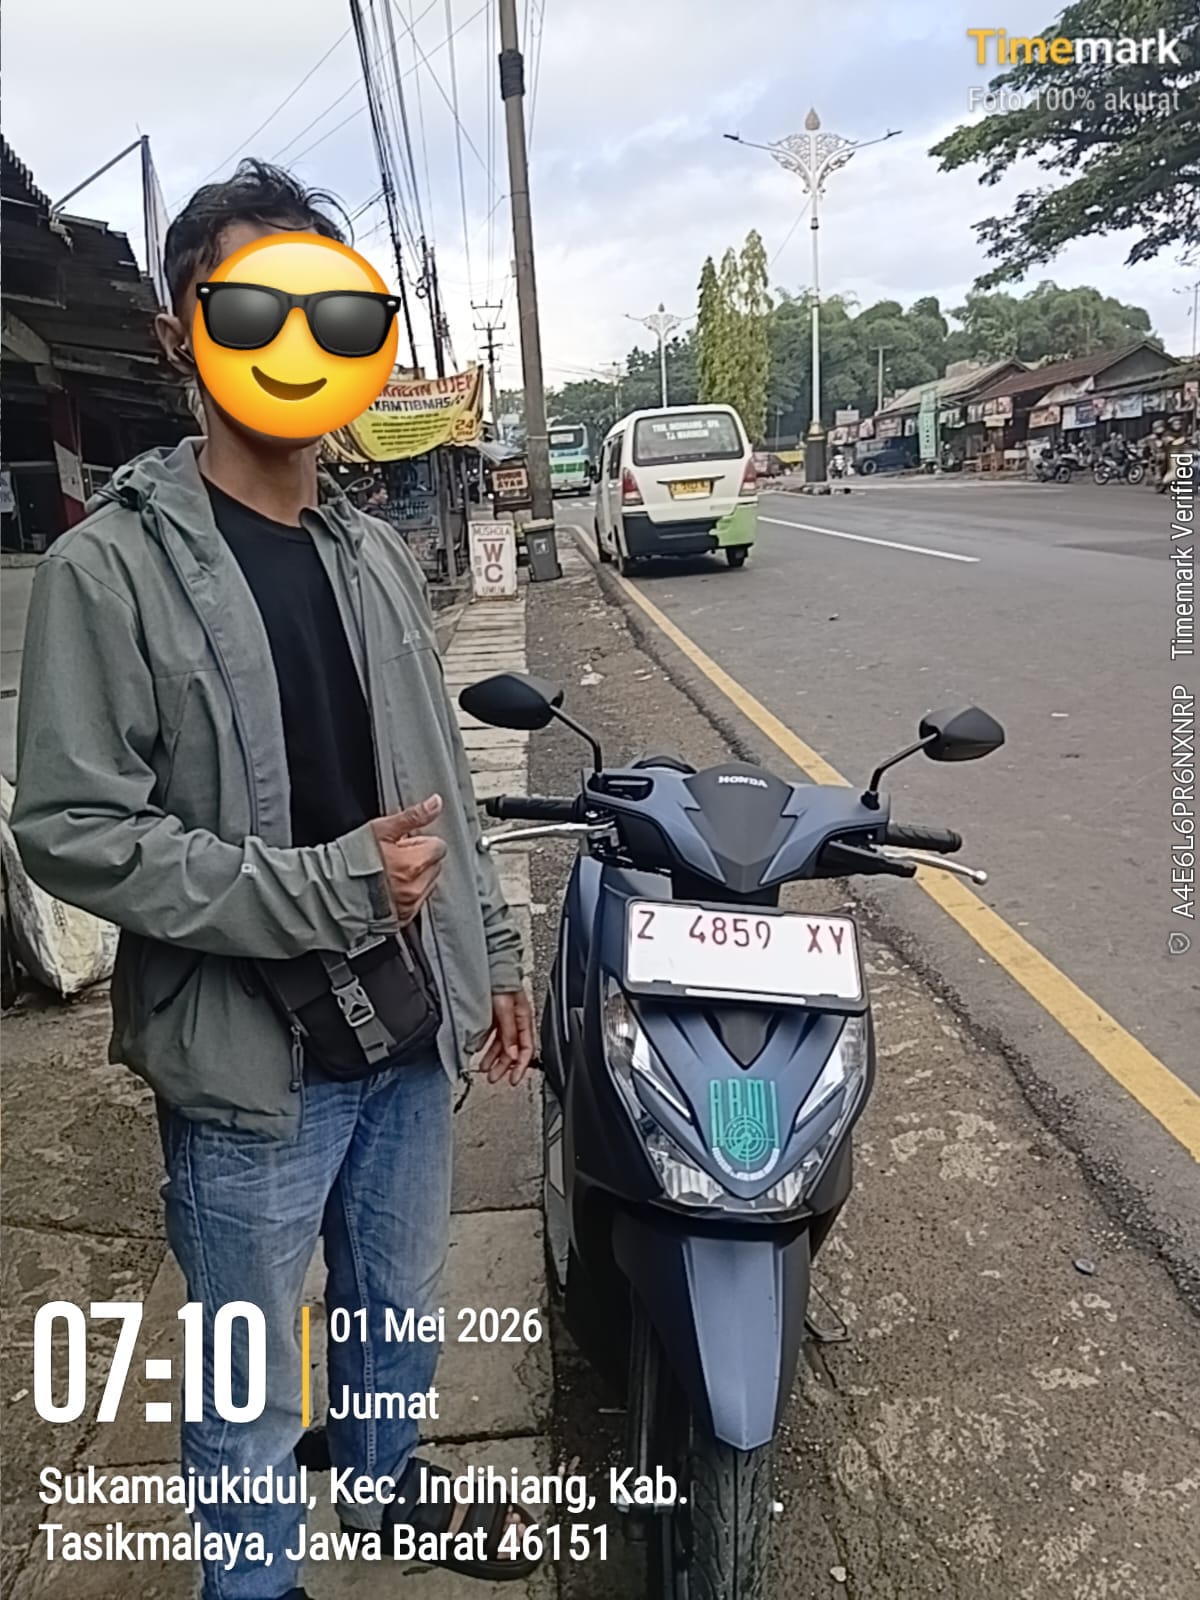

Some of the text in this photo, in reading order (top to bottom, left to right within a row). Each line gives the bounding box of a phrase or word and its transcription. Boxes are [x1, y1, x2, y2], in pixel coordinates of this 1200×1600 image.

[718, 775, 768, 788] HONDA
[637, 910, 655, 940] Z
[689, 915, 772, 949] 4859
